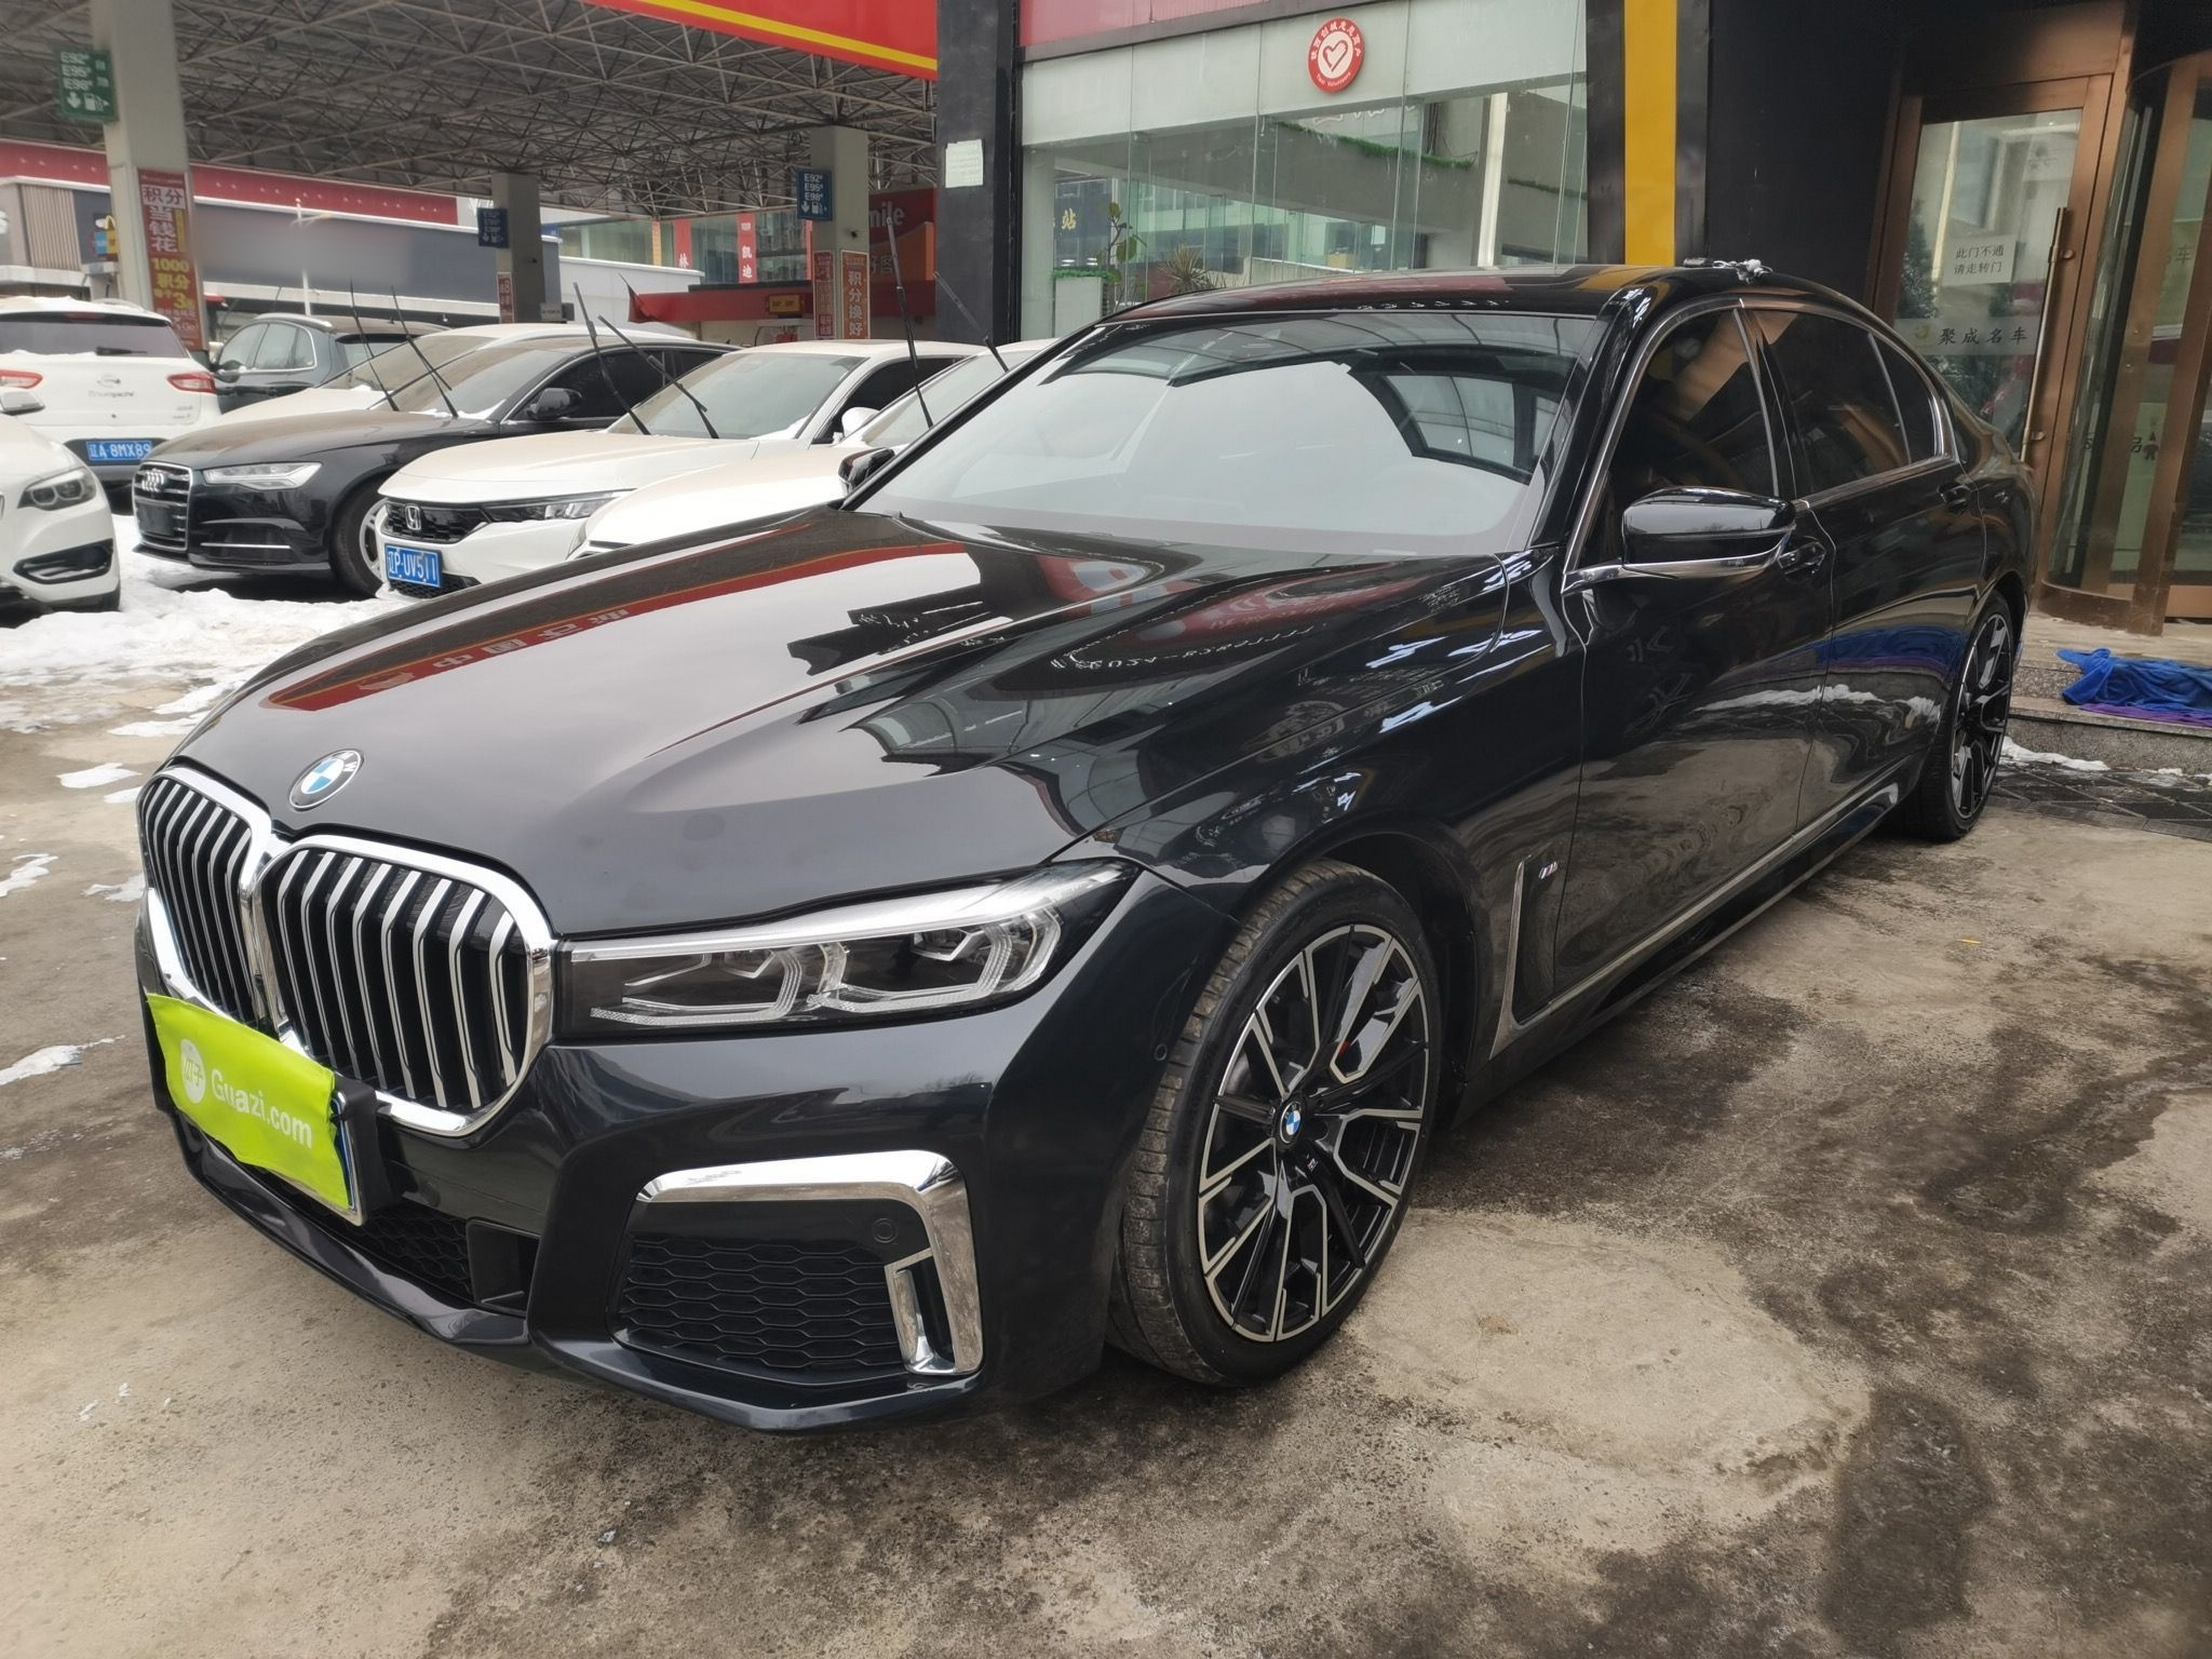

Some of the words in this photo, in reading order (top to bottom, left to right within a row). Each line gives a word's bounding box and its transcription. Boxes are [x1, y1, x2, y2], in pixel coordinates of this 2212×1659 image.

[142, 186, 183, 204] 积分
[1955, 244, 2004, 259] 此门不通
[1938, 327, 2027, 345] 聚成名车
[211, 1069, 312, 1148] Guazi.com
